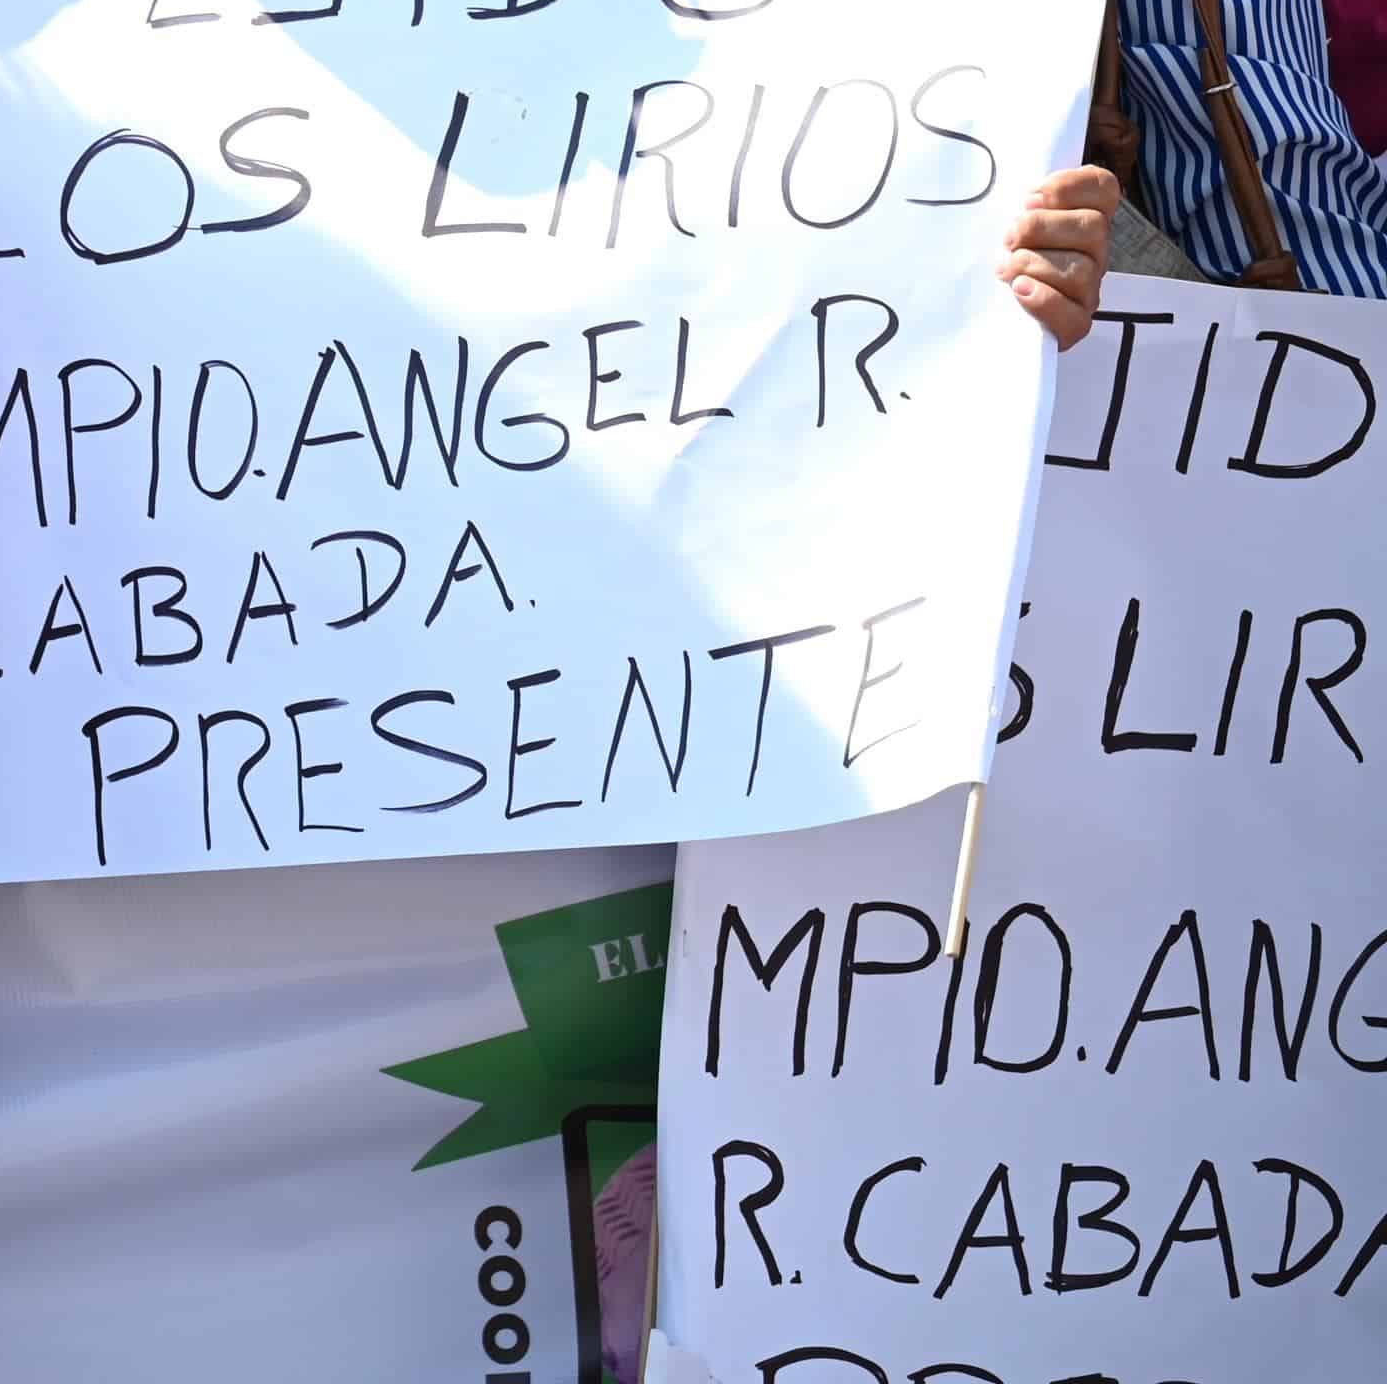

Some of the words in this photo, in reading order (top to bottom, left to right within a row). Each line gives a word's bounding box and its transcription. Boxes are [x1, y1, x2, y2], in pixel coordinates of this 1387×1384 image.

[420, 64, 999, 251] LIRIOS
[811, 293, 912, 429] R.
[82, 596, 927, 867] PRESENTE
[587, 933, 664, 983] EL
[474, 1204, 531, 1384] COO
[713, 1139, 804, 1289] R.
